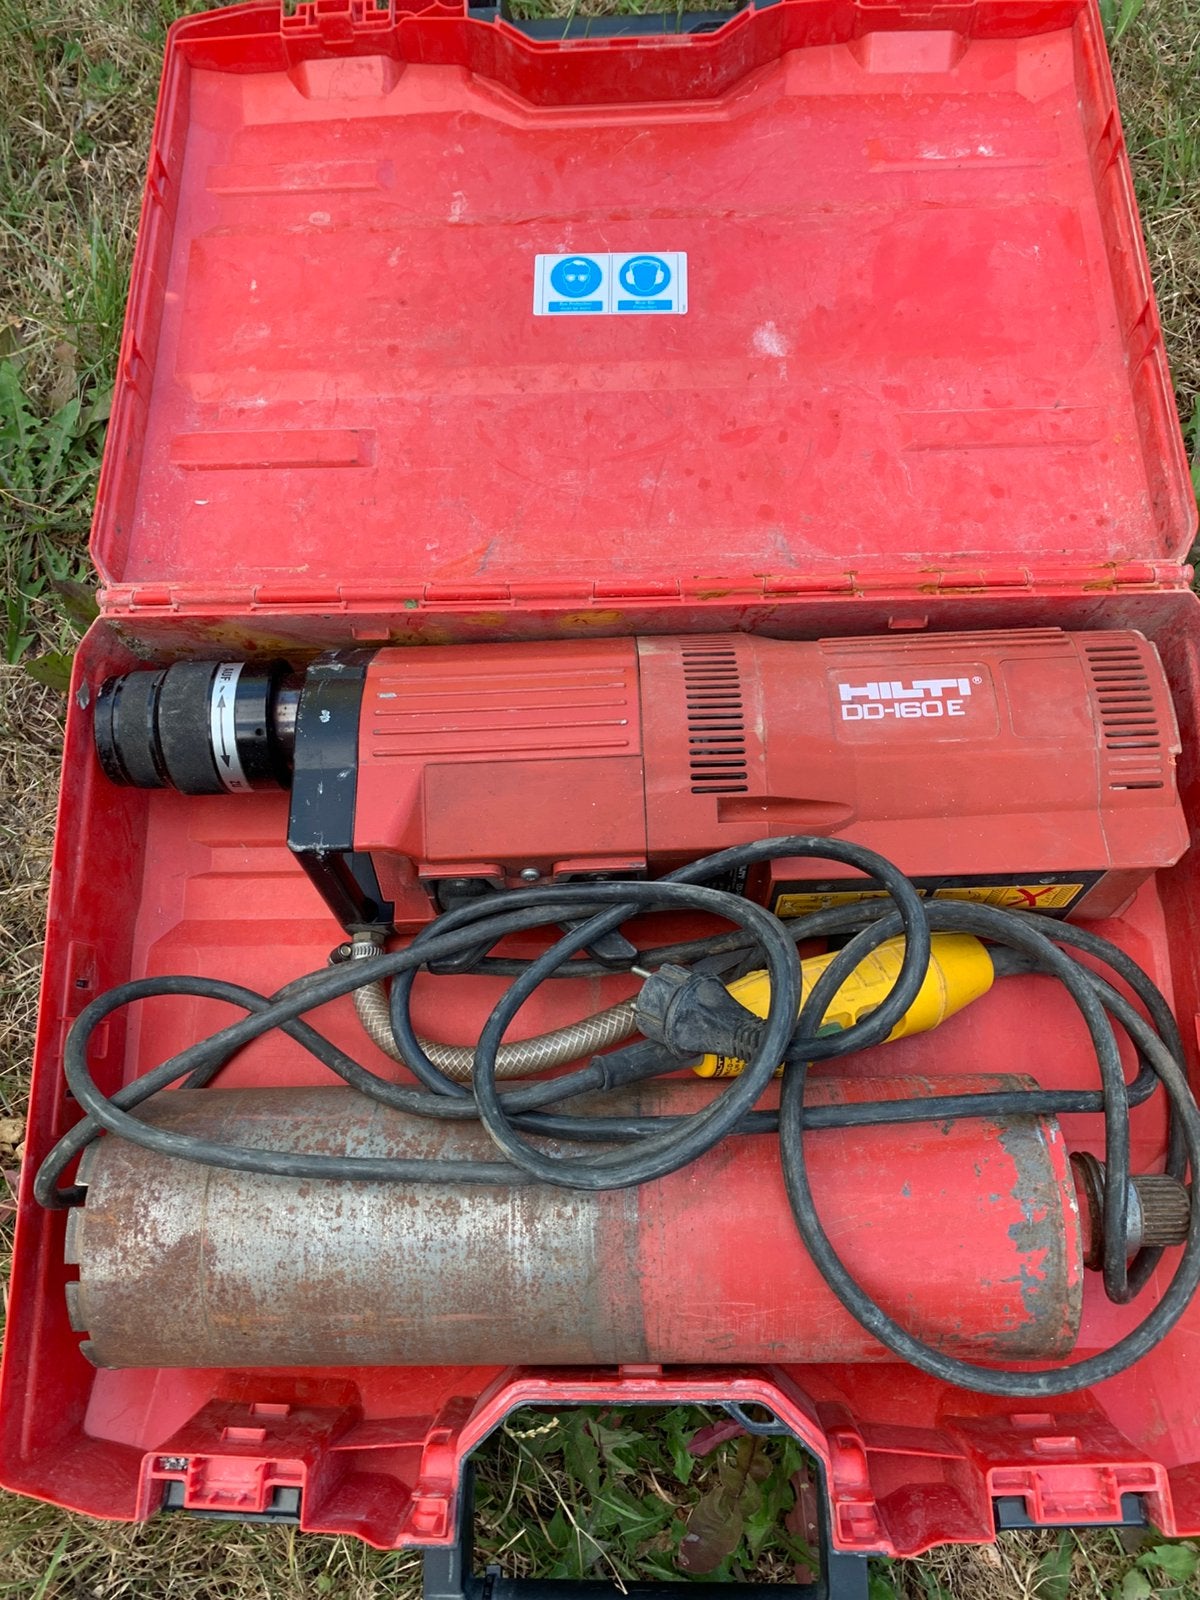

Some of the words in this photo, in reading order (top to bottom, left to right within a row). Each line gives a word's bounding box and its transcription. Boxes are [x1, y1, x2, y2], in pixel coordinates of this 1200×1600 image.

[838, 678, 972, 701] HILTI
[841, 700, 944, 721] DD-160
[946, 699, 966, 716] E
